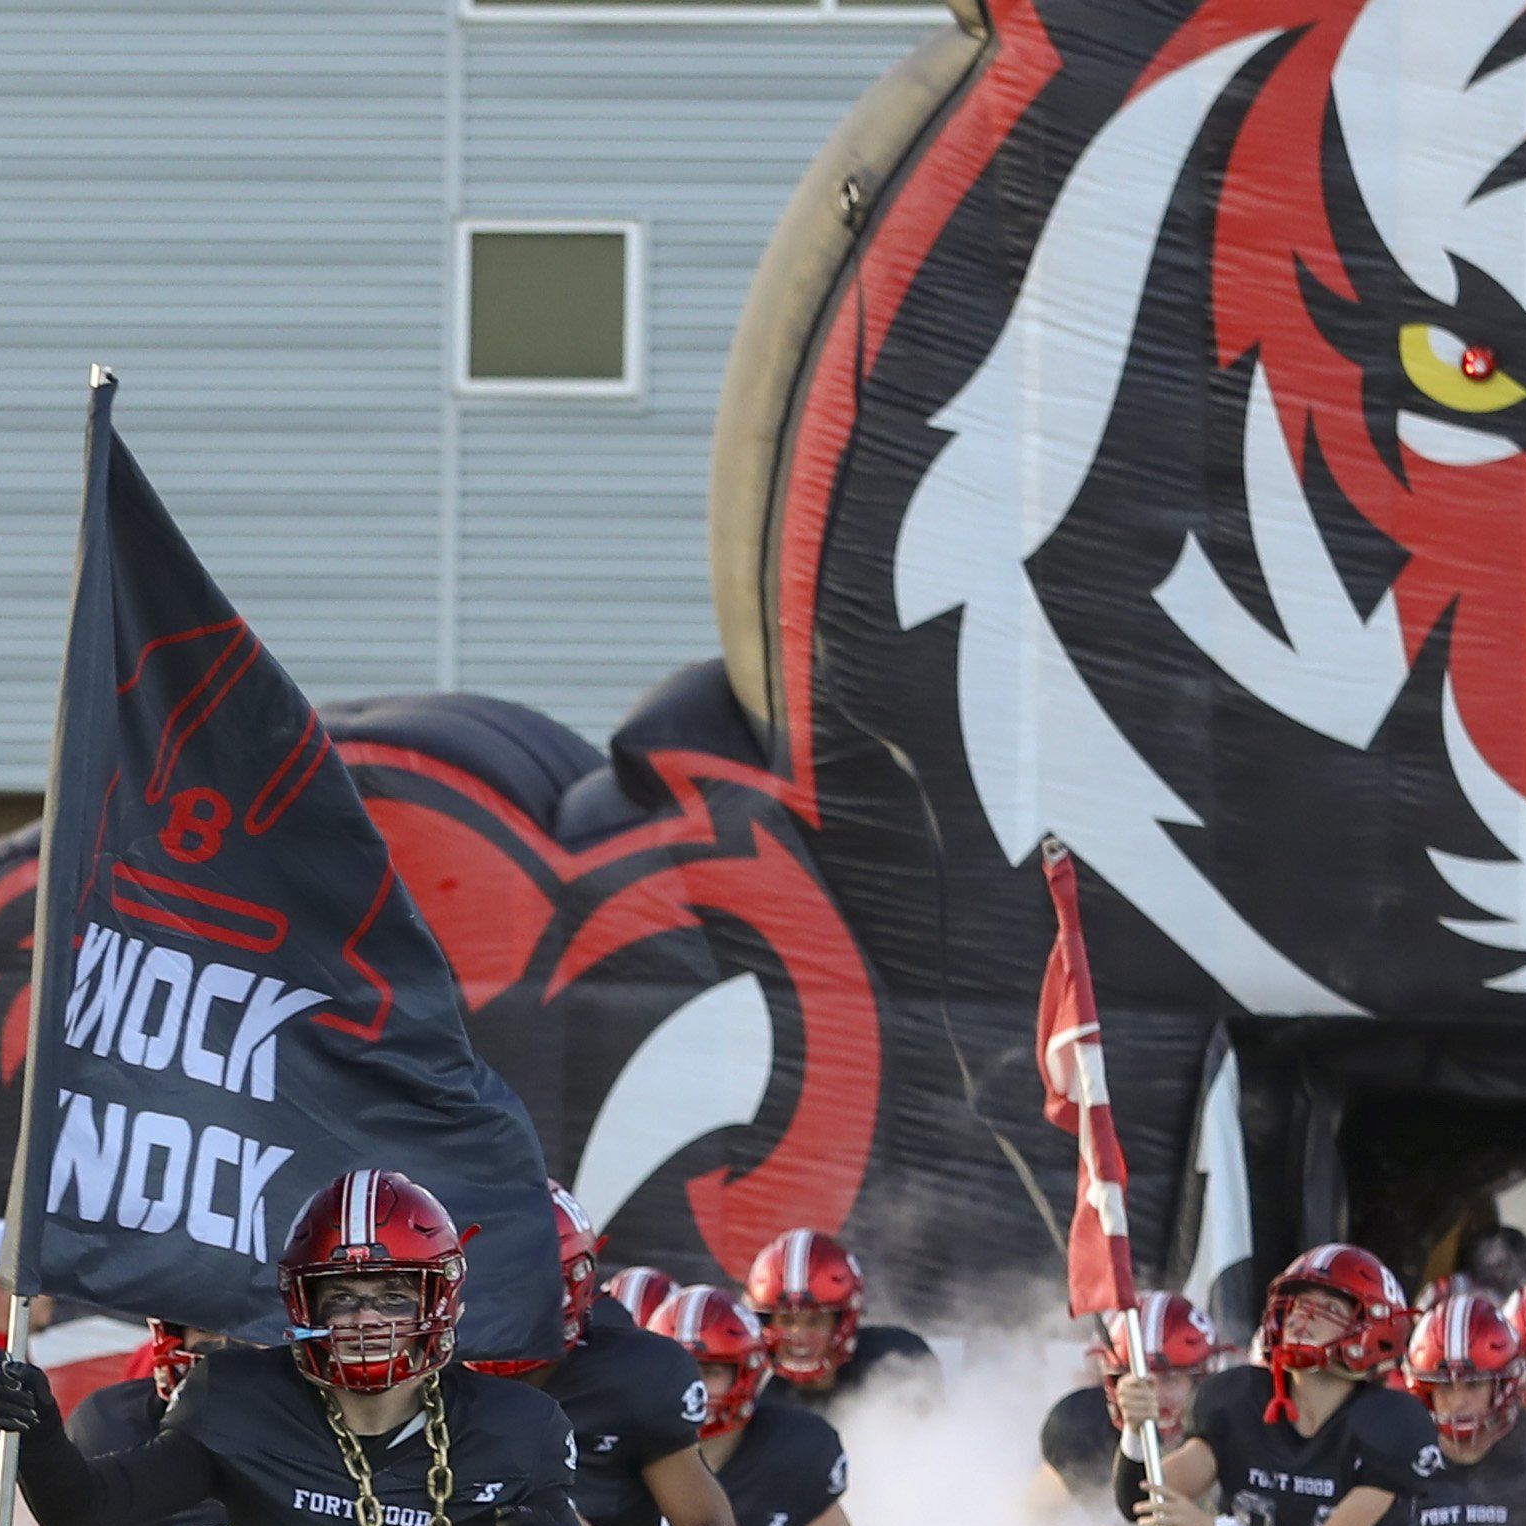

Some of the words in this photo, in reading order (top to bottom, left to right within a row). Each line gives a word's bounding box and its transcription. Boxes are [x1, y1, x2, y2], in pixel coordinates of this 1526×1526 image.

[158, 786, 233, 864] B
[46, 1088, 295, 1263] NOCK
[1293, 1475, 1335, 1497] HOOD
[293, 1489, 358, 1520] FORT
[1420, 1507, 1461, 1526] FORT
[1466, 1504, 1508, 1523] HOOD
